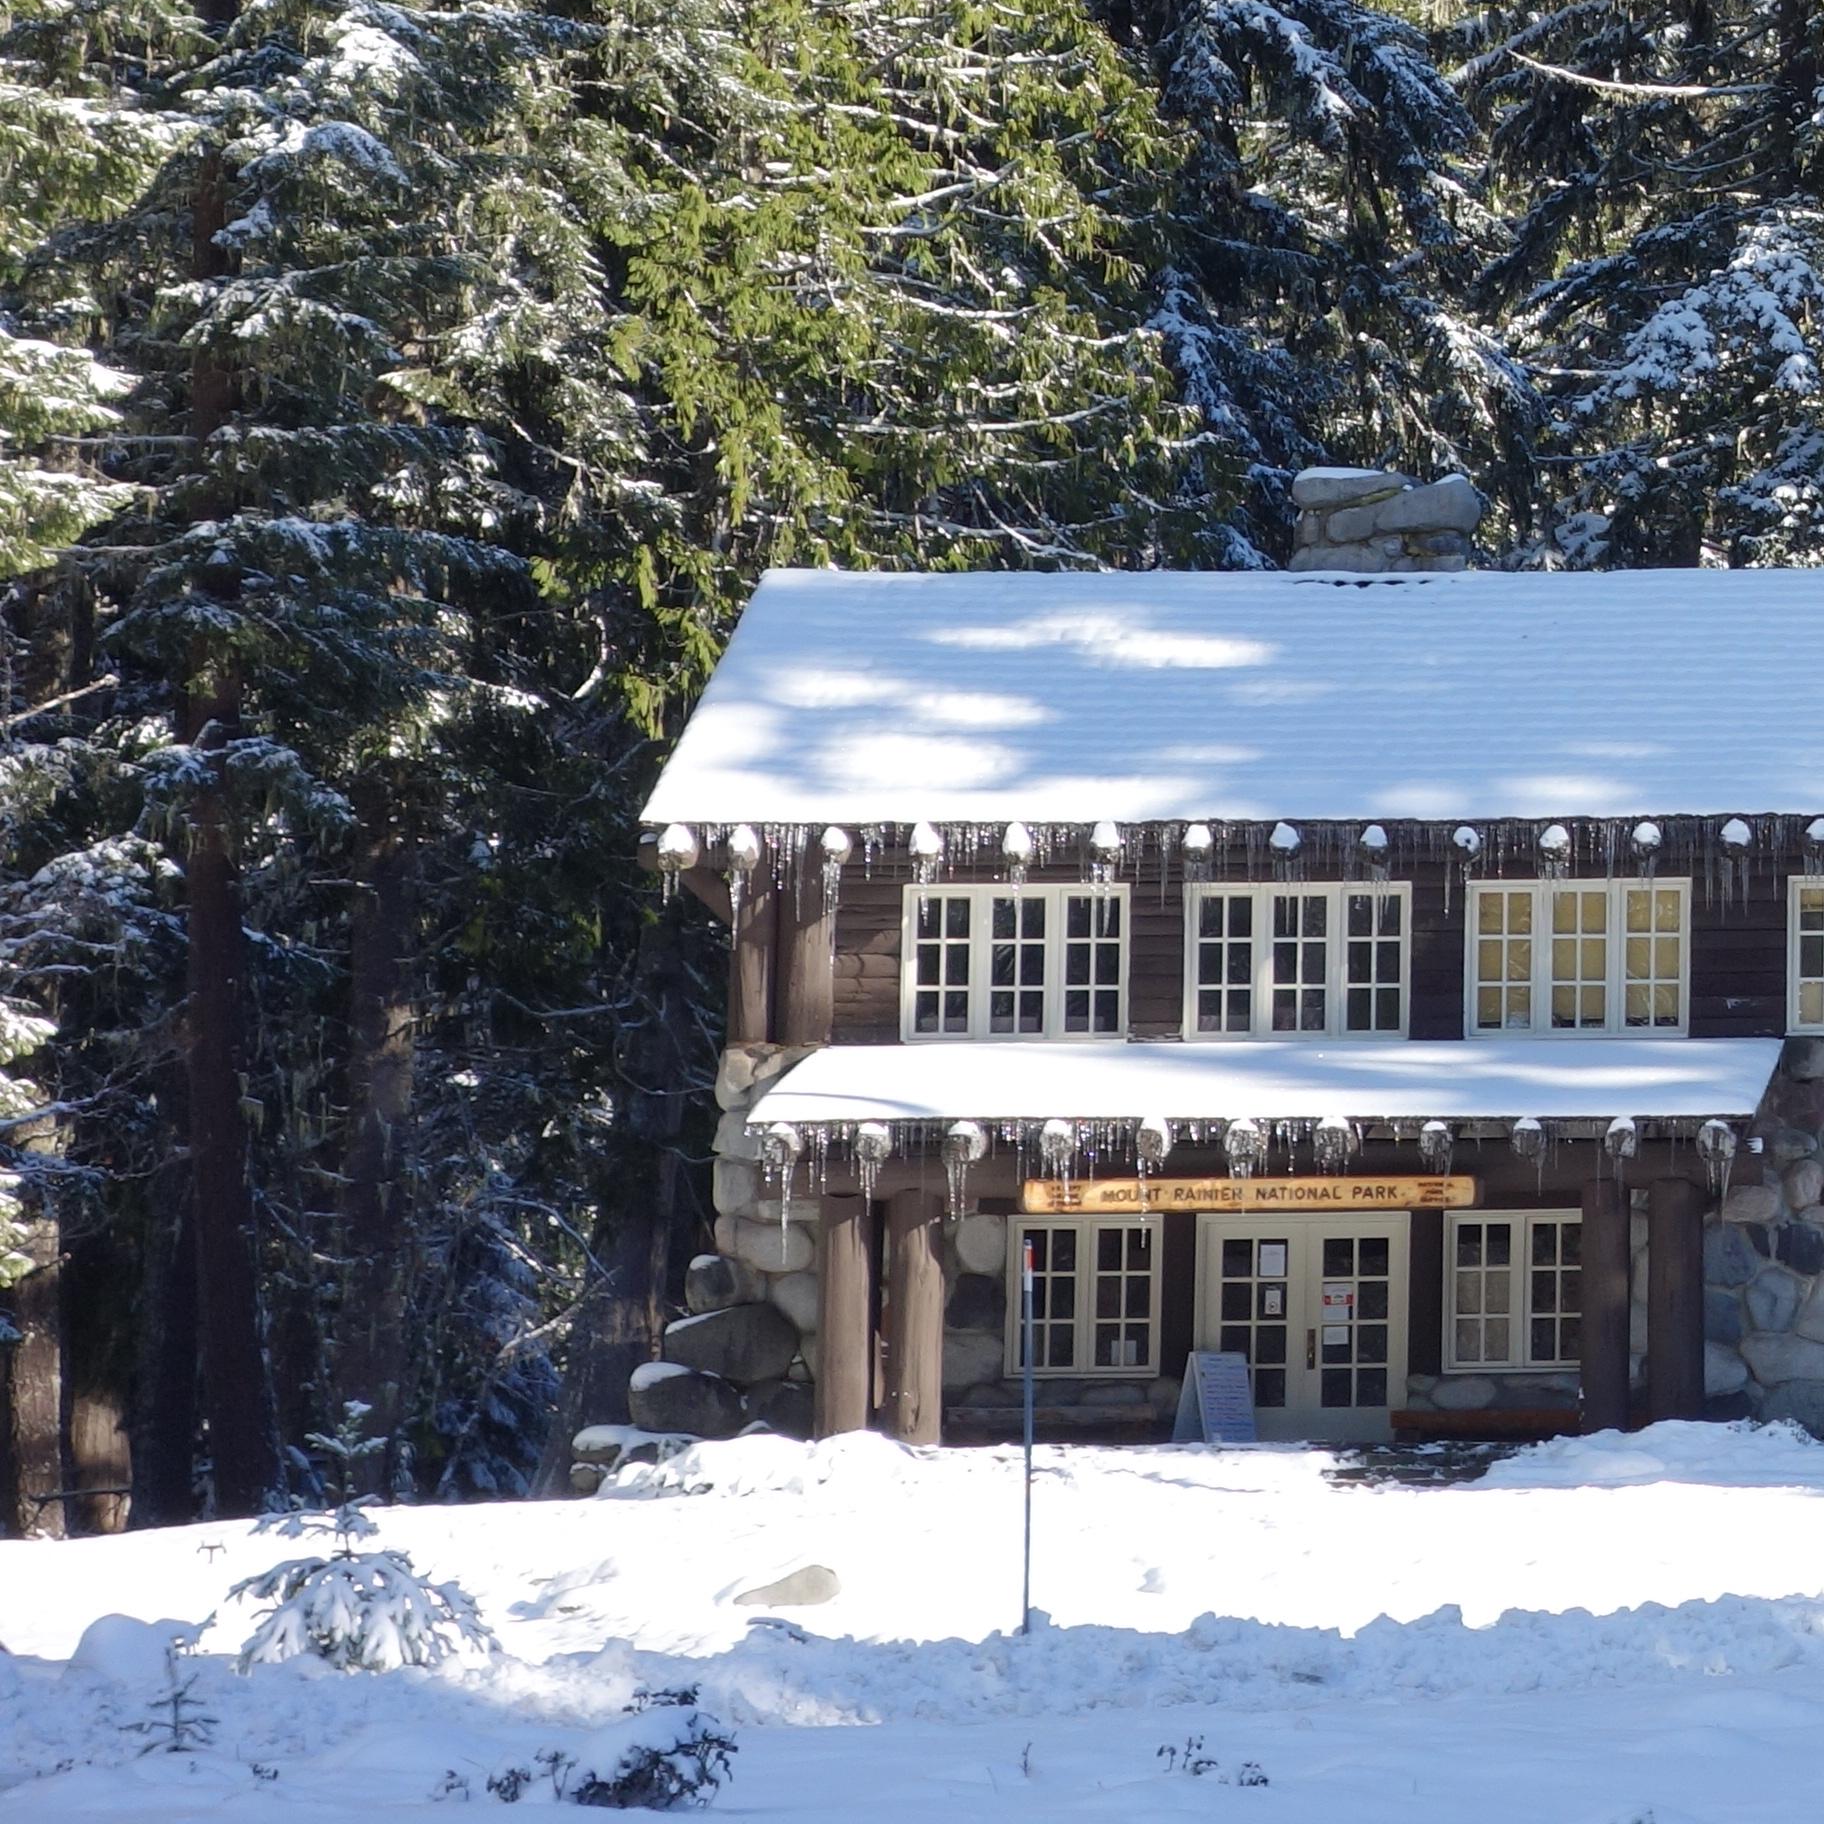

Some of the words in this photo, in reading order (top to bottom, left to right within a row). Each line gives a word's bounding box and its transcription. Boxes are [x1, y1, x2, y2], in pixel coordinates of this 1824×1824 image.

[1101, 1187, 1161, 1202] MOUNT
[1174, 1187, 1242, 1201] RAINIER
[1255, 1186, 1342, 1201] NATIONAL
[1352, 1186, 1398, 1199] PARK
